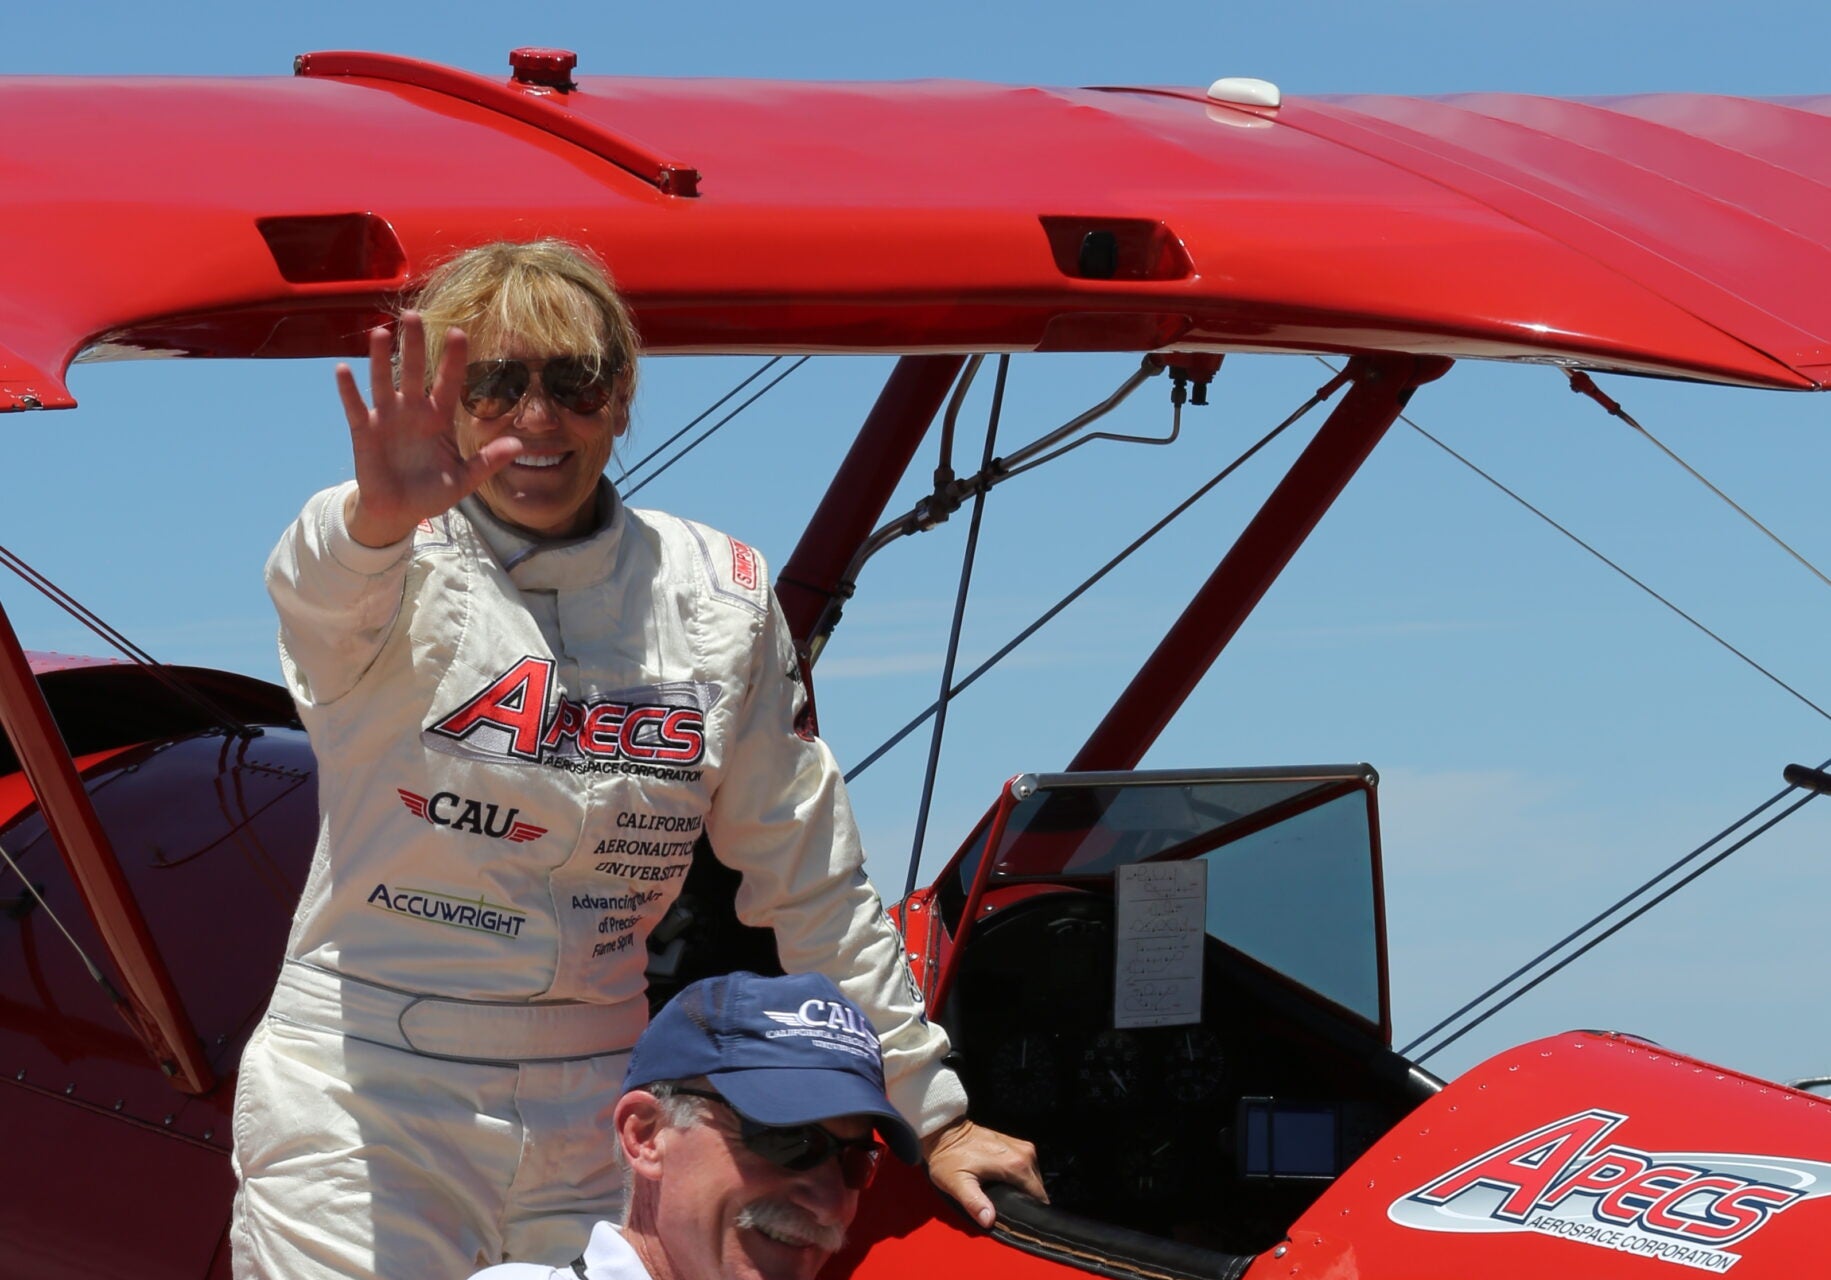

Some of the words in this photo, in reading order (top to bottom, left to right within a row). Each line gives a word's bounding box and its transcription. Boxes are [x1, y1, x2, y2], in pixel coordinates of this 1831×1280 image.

[422, 655, 706, 766] APECS
[544, 755, 619, 775] AEROSPACE
[620, 762, 704, 782] CORPORATION
[427, 791, 520, 839] CAU
[616, 811, 703, 833] CALIFORNIA
[593, 838, 696, 857] AERONAUTIC
[594, 862, 689, 881] UNIVERSITY
[367, 883, 526, 936] ACCUWRIGHT
[572, 893, 637, 912] Advancing
[1404, 1108, 1810, 1247] APECS
[1528, 1215, 1624, 1248] AEROSPACE
[1620, 1235, 1735, 1271] CORPORATION
